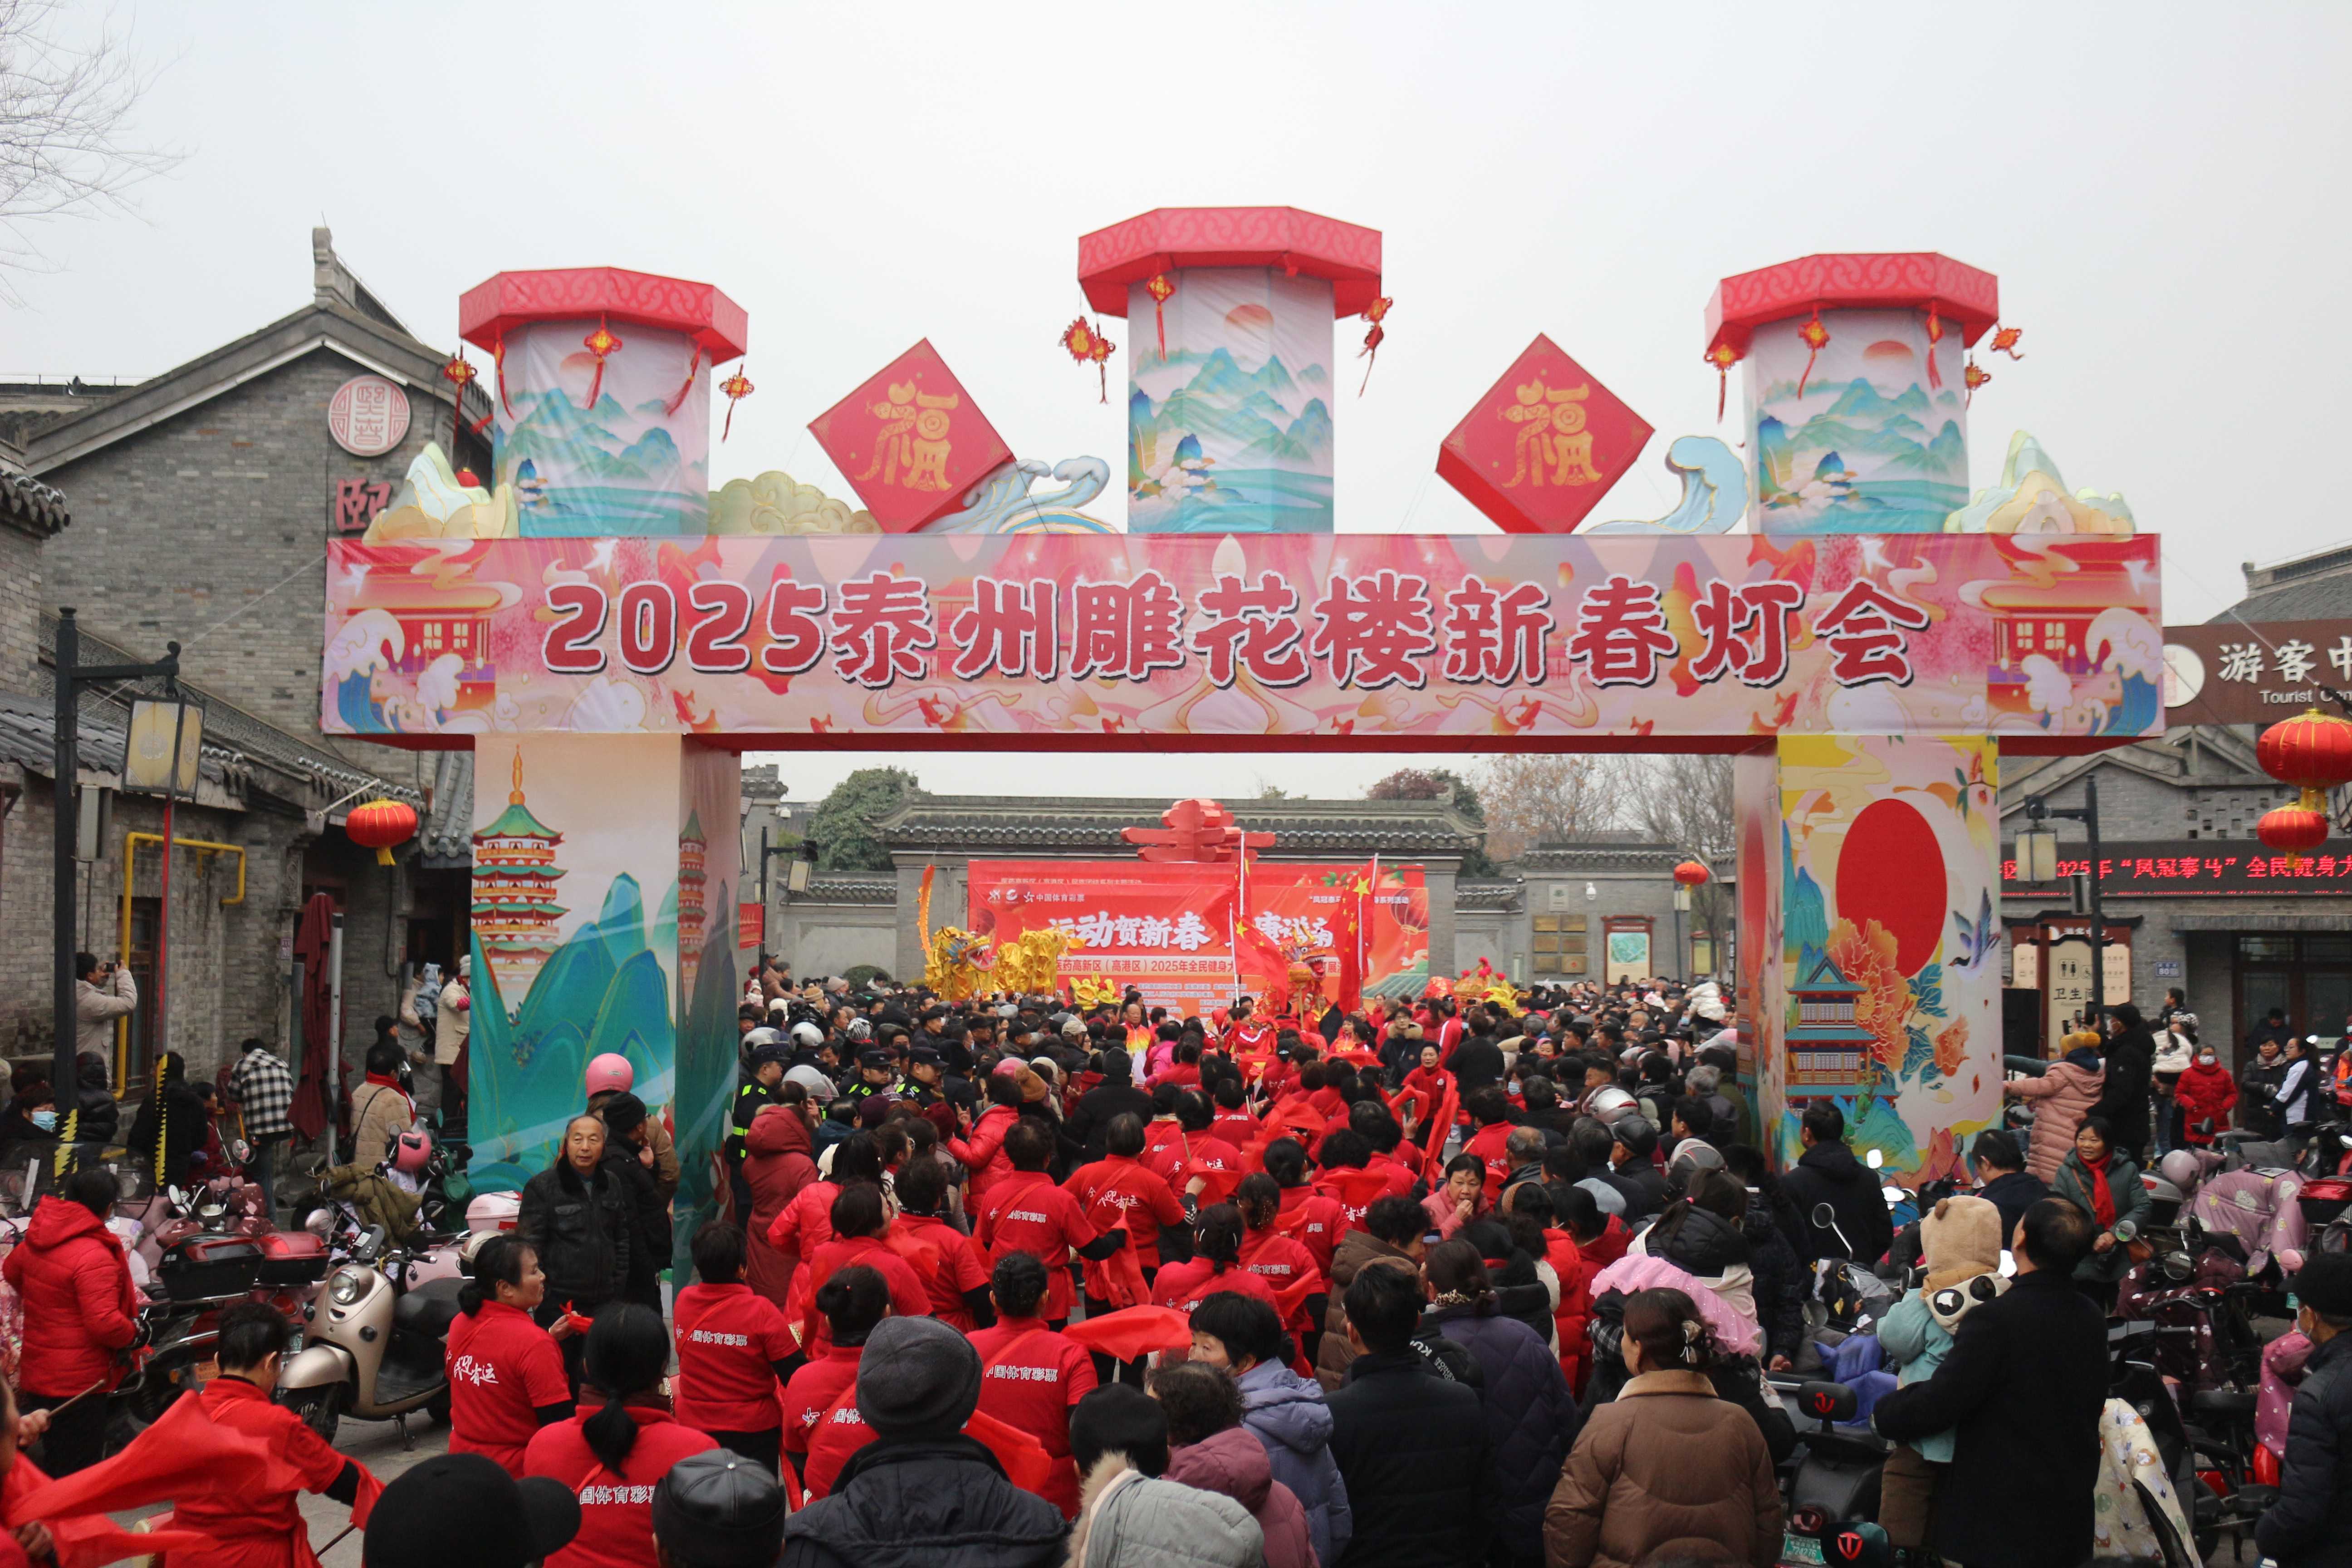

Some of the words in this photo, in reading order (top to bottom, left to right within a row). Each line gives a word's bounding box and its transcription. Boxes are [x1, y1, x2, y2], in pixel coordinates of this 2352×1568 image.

[543, 569, 1931, 690] 2025泰州雕花楼新春灯会
[2259, 689, 2313, 705] Tourist
[1036, 893, 1085, 902] 中国体育彩票
